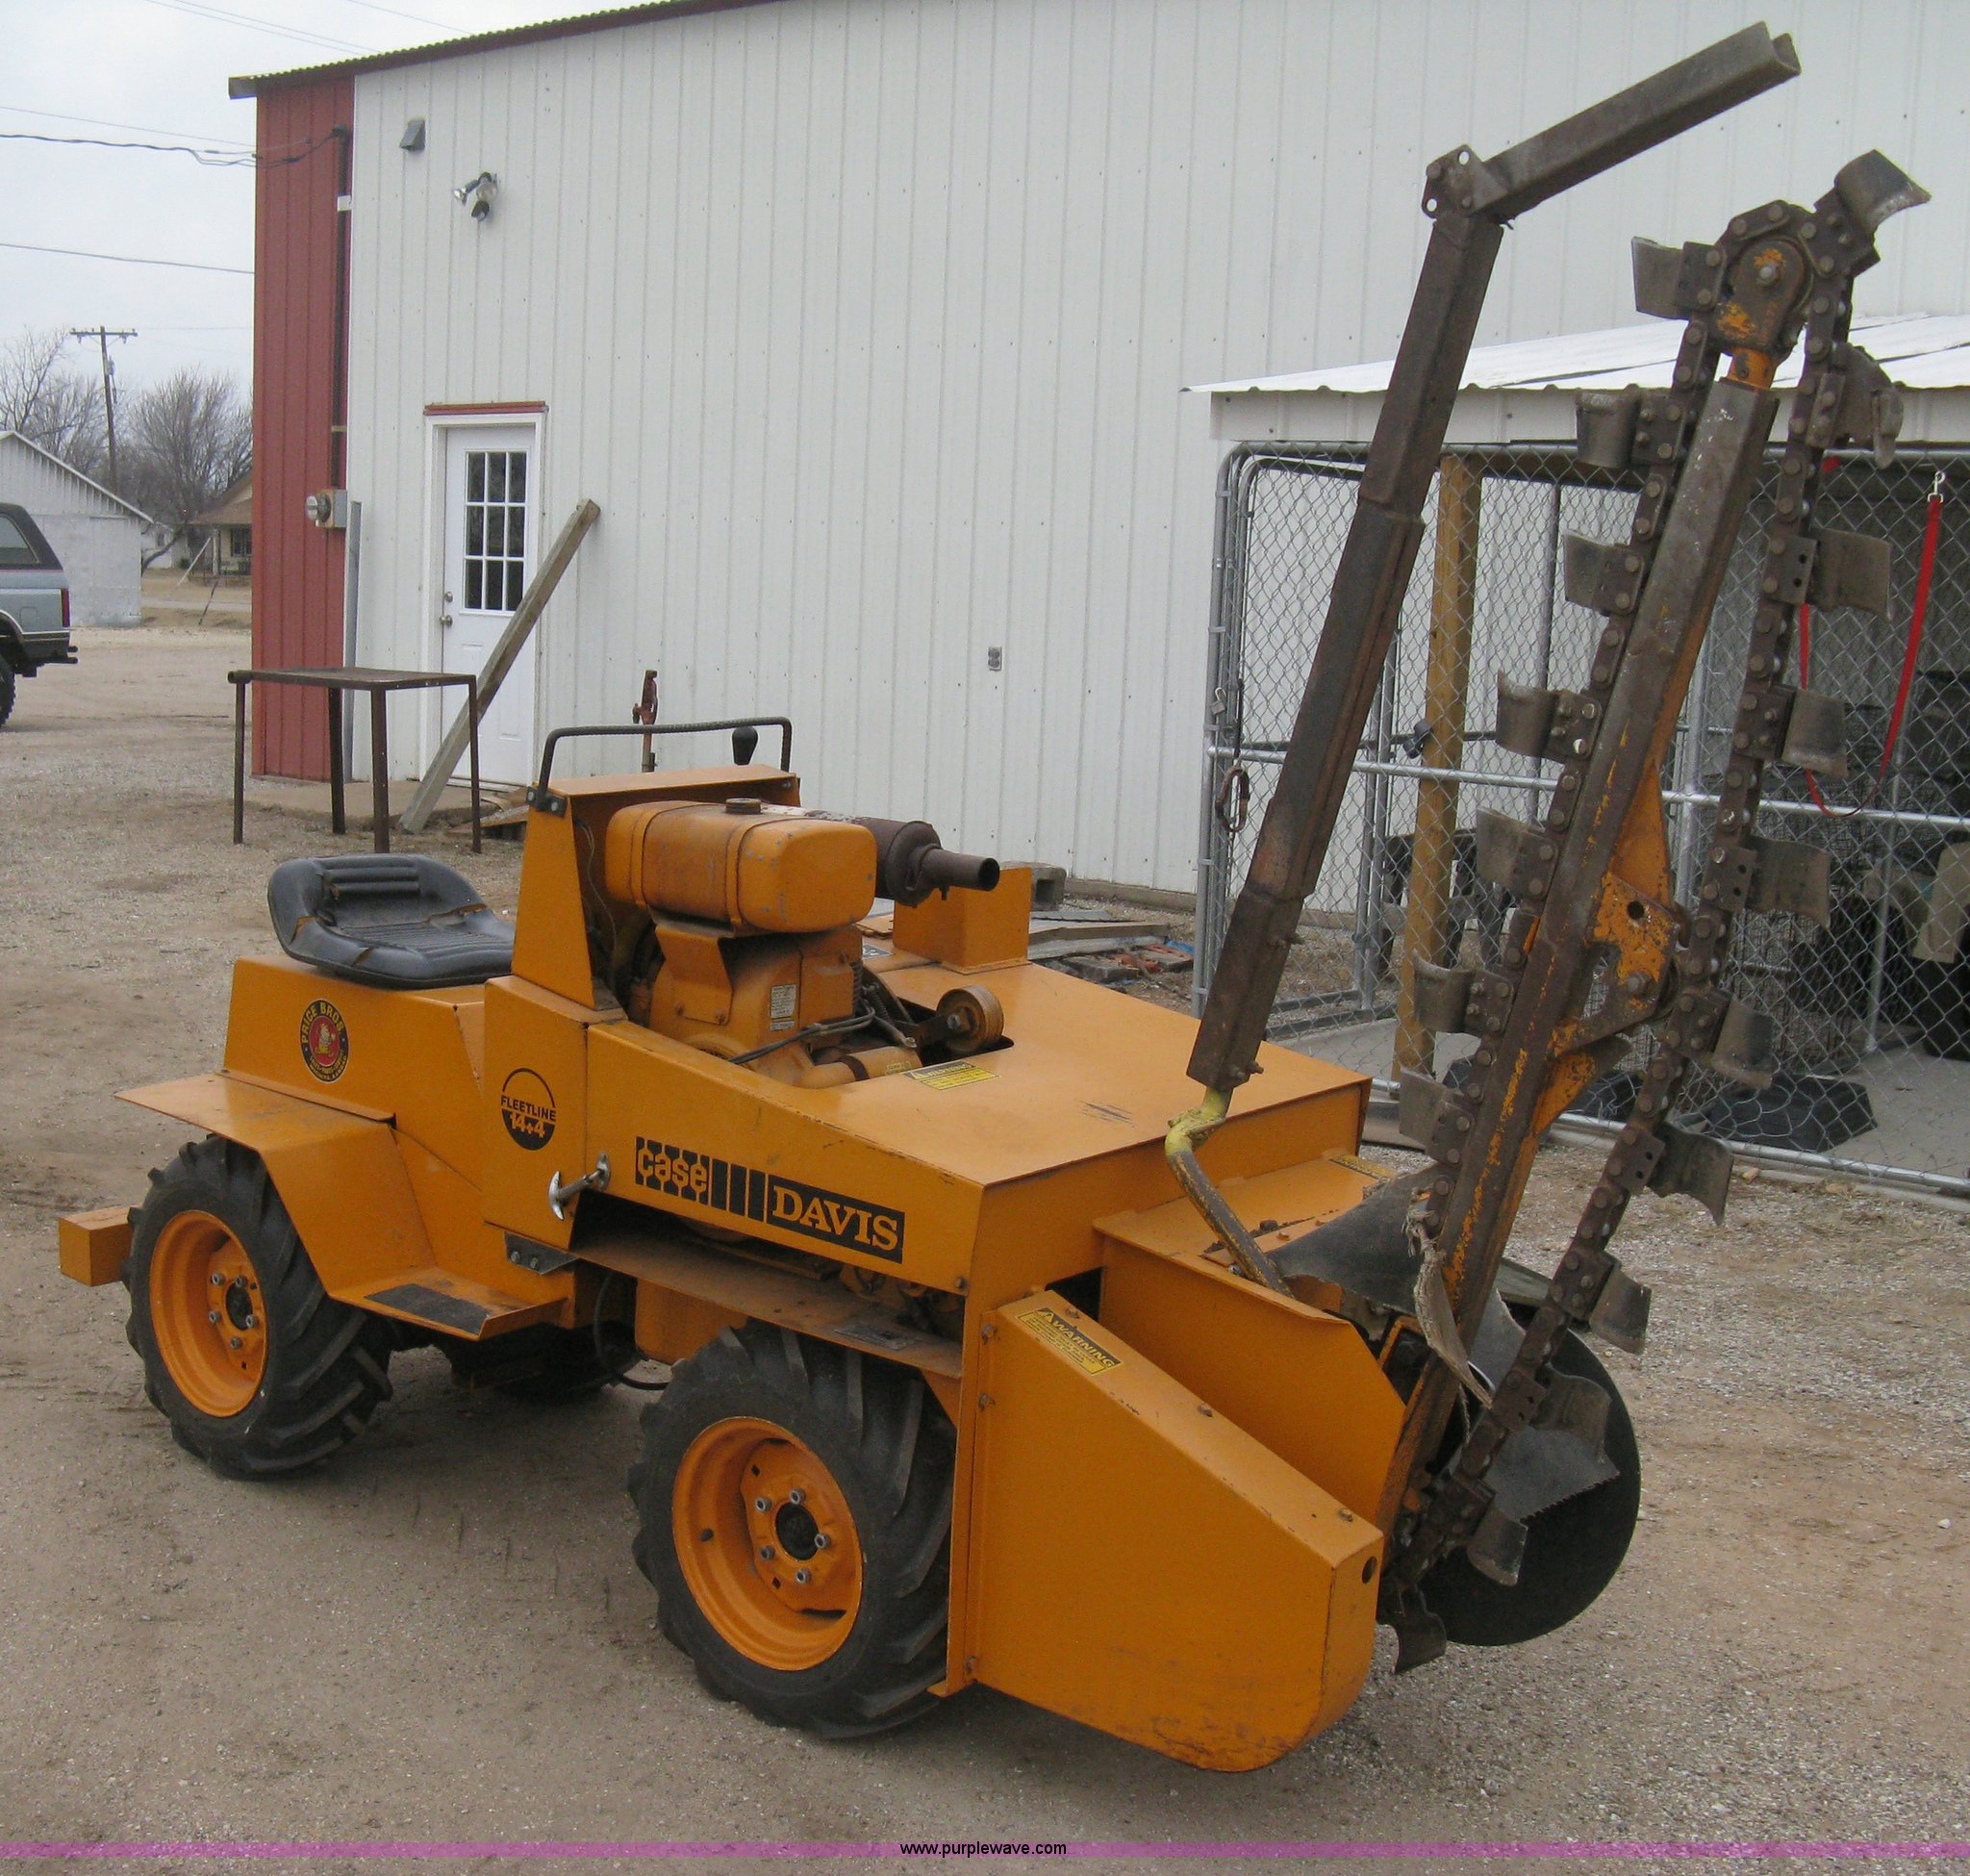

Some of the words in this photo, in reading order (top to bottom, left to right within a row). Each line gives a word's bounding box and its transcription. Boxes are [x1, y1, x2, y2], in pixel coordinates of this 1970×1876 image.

[301, 1004, 318, 1044] PRICE
[500, 1095, 557, 1122] FLEETLINE
[771, 1184, 898, 1252] DAVIS
[1051, 1320, 1115, 1367] WARNING
